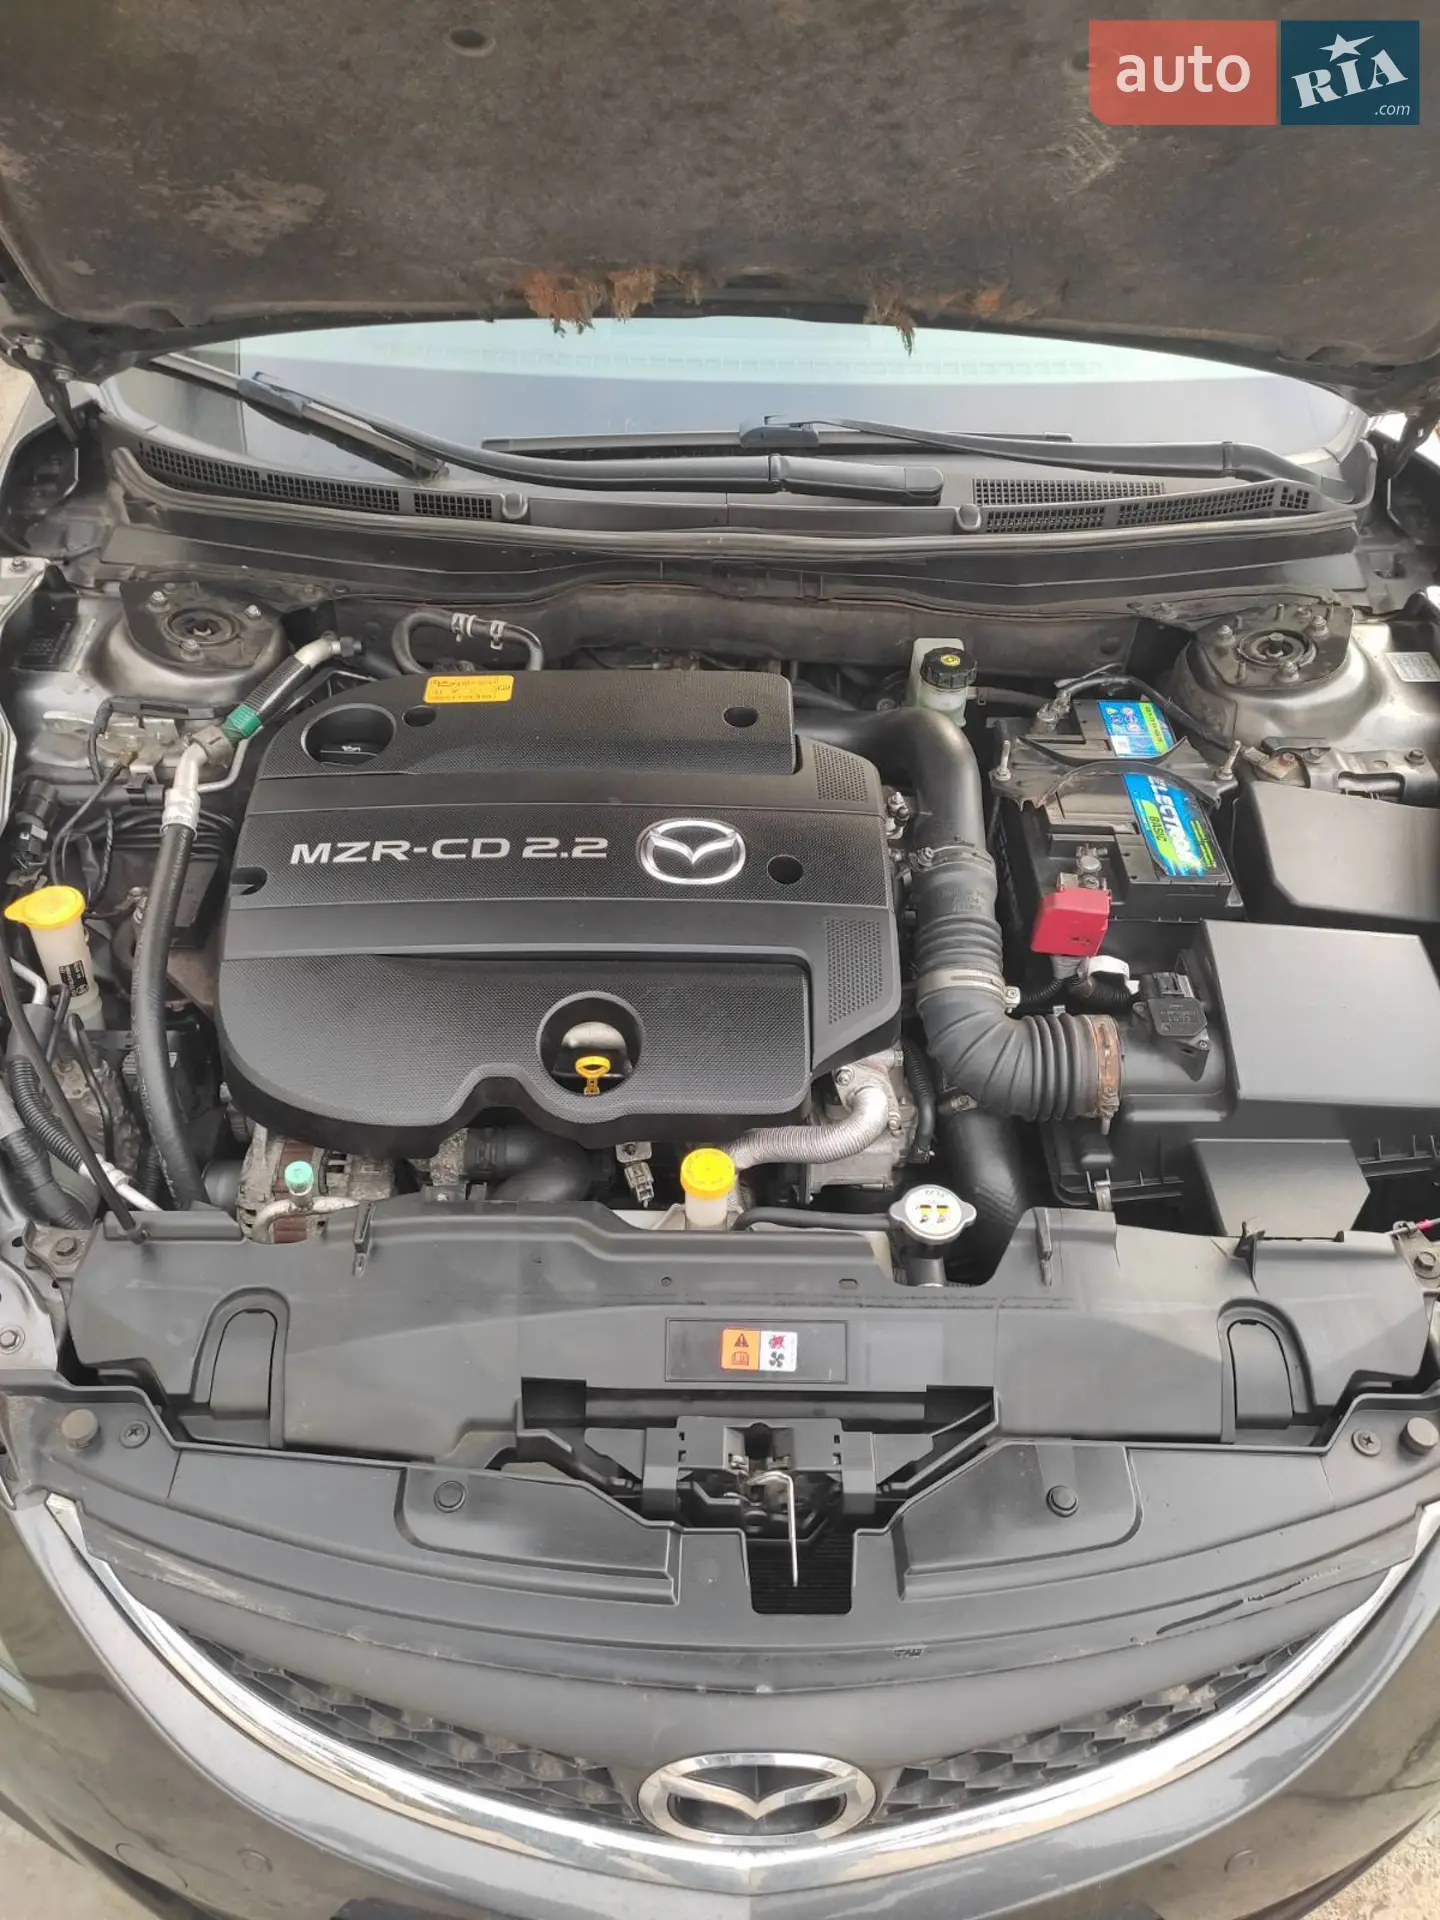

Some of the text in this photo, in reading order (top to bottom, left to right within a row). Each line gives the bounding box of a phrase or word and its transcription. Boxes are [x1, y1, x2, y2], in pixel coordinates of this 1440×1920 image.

[1149, 815, 1168, 842] BASIC
[290, 836, 609, 865] MZR-CD 2.2
